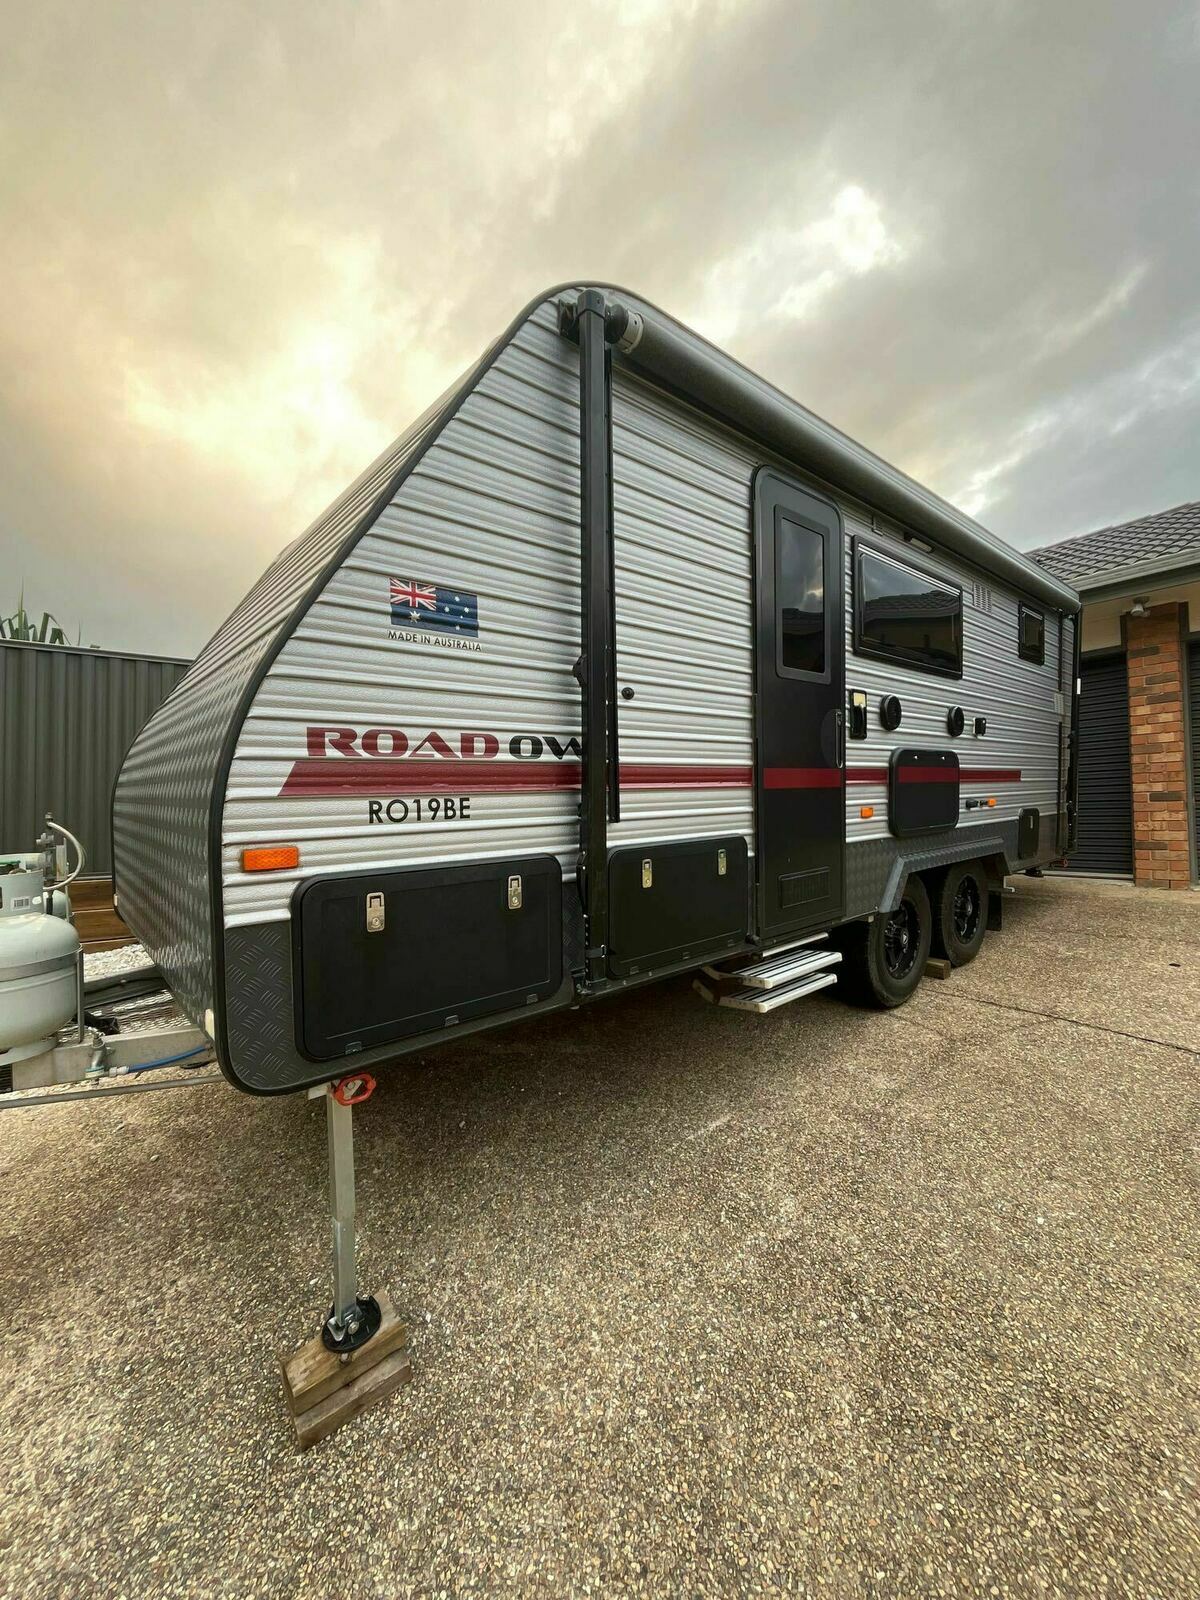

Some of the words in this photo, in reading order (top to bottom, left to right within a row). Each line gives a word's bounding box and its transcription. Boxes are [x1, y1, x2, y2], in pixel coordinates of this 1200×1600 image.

[388, 630, 417, 643] MADE
[420, 634, 431, 645] IN
[434, 636, 482, 651] AUSTRALIA
[306, 727, 499, 759] ROAD
[508, 735, 582, 760] OW
